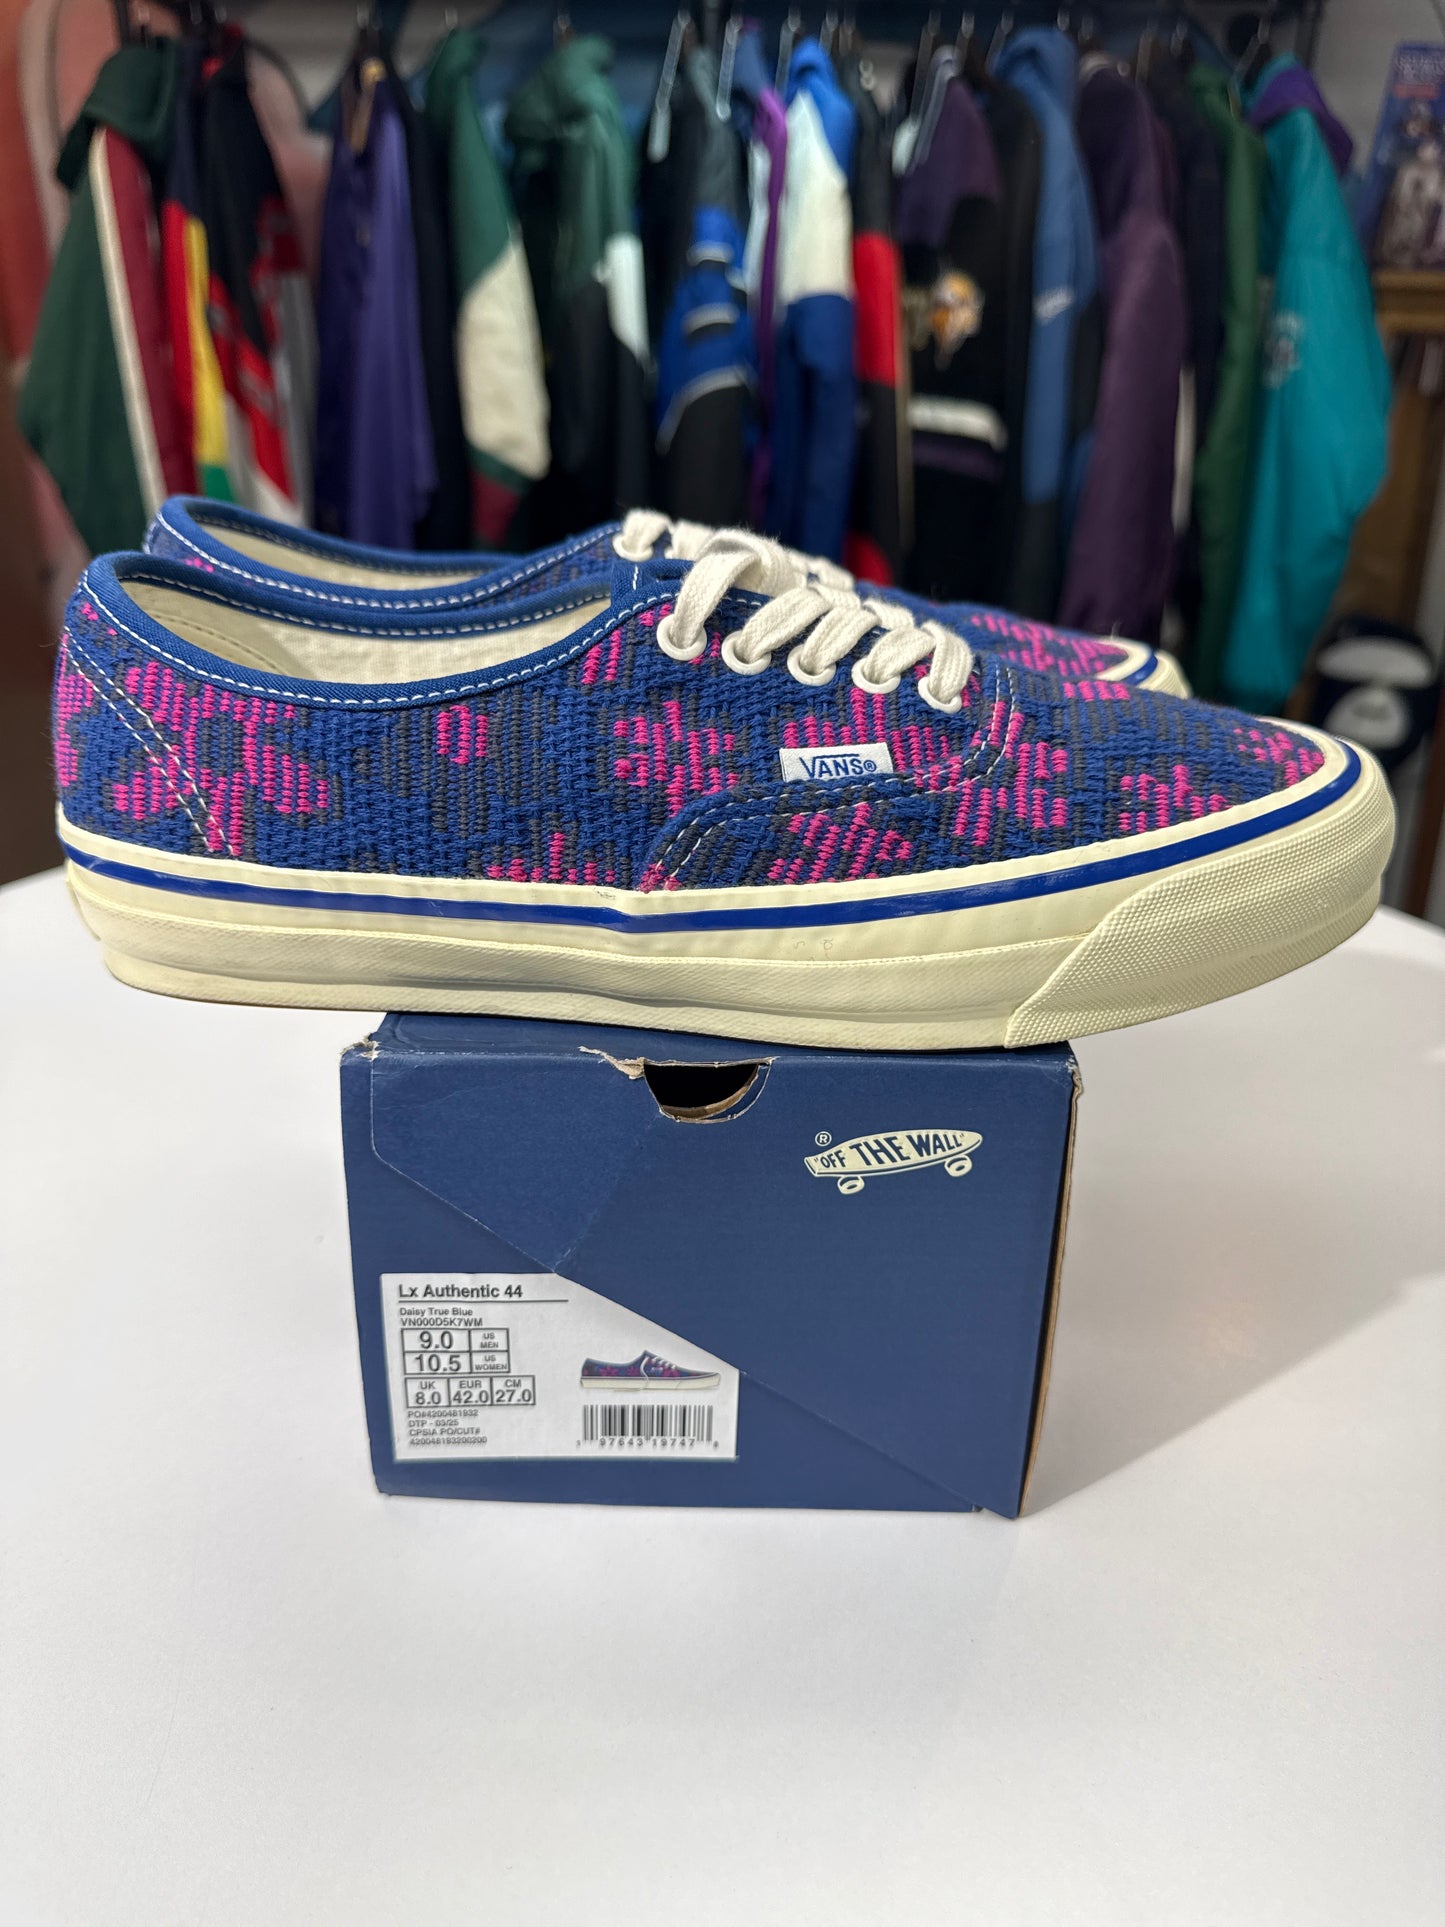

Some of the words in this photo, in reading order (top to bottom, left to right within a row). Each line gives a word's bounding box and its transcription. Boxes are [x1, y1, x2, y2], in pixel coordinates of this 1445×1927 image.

[849, 1136, 911, 1166] THE
[399, 1285, 418, 1298] Lx
[423, 1285, 500, 1299] Authentic
[504, 1285, 523, 1298] 44
[400, 1308, 426, 1317] Daisy
[429, 1308, 450, 1316] True
[453, 1308, 473, 1316] Blue
[401, 1317, 483, 1327] VN000D5K7WM
[419, 1331, 453, 1349] 9.0
[415, 1354, 461, 1372] 10.5
[420, 1381, 435, 1390] UK
[459, 1380, 482, 1389] EUR
[505, 1379, 521, 1388] CM
[415, 1391, 441, 1405] 8.0
[453, 1390, 489, 1404] 42.0
[495, 1389, 532, 1403] 27.0
